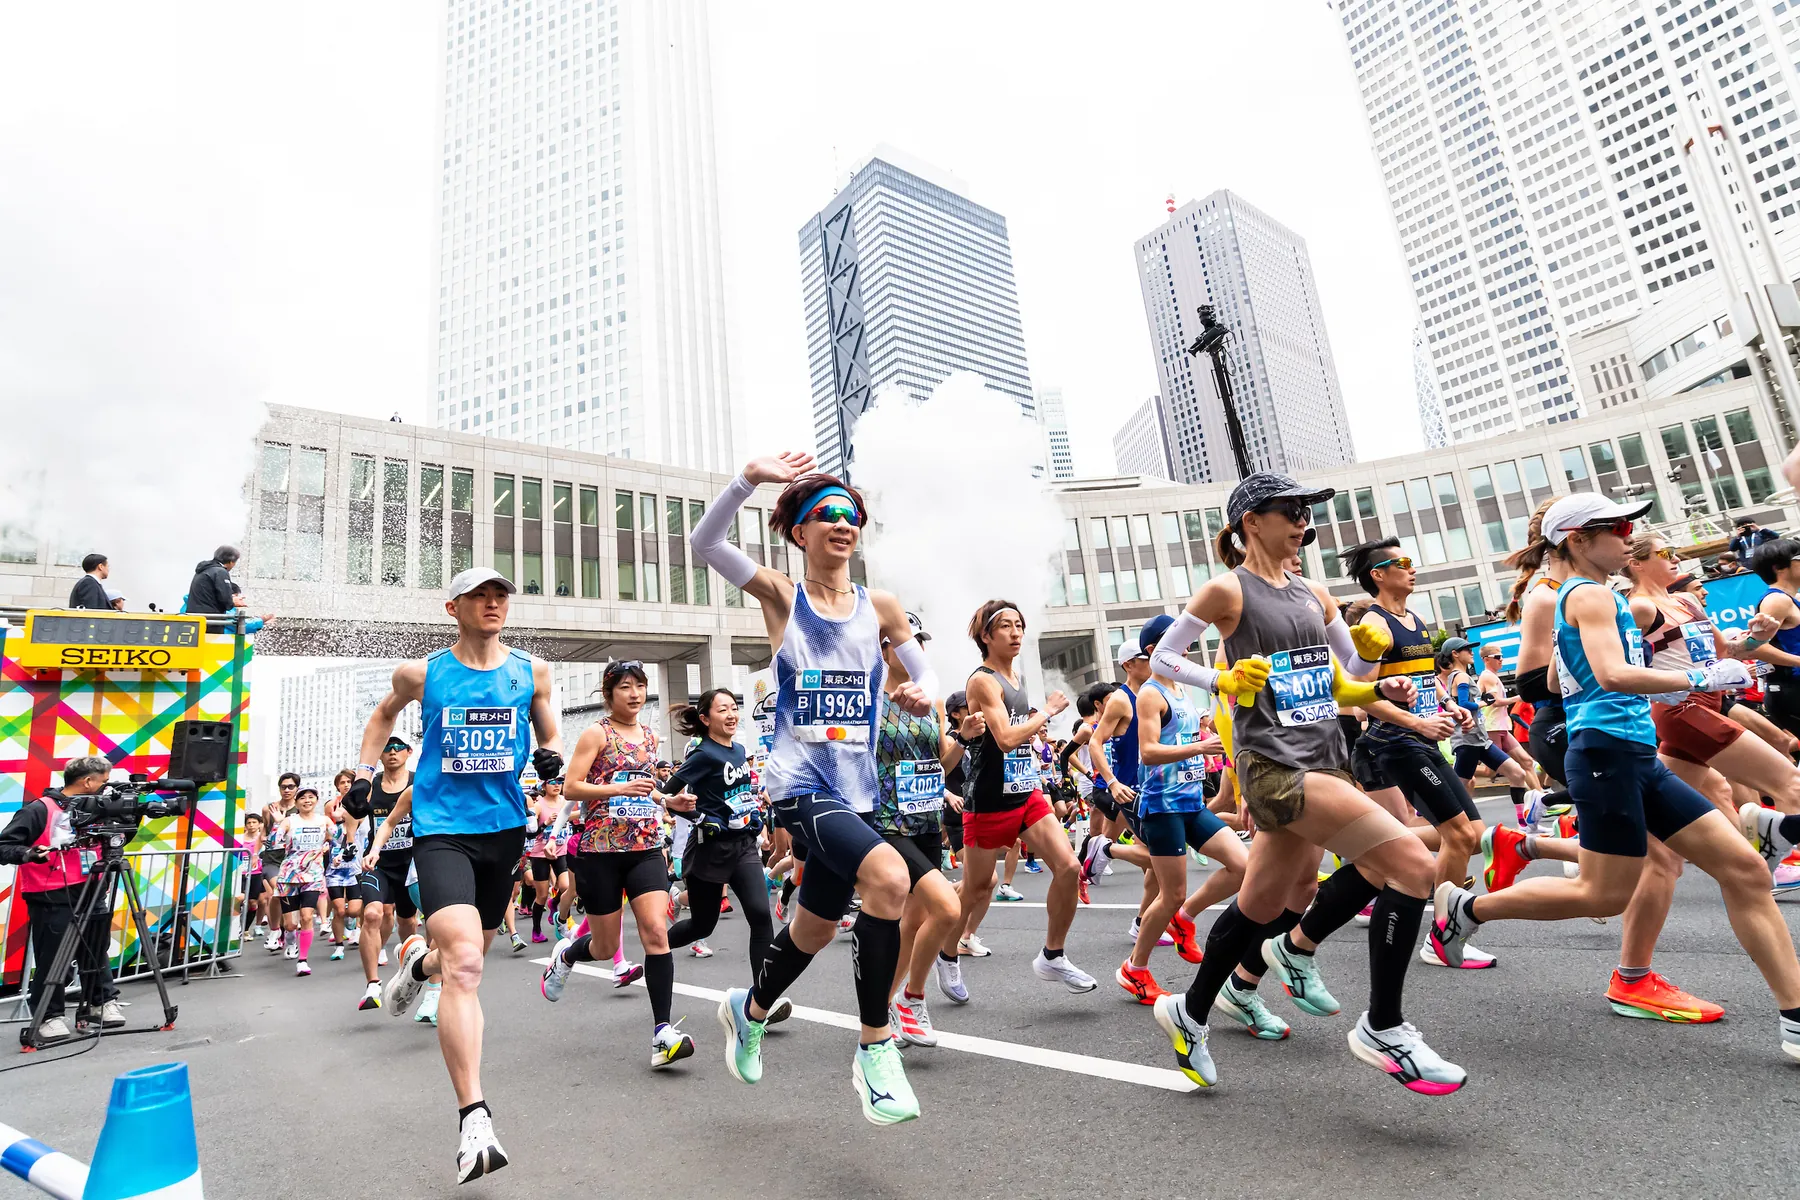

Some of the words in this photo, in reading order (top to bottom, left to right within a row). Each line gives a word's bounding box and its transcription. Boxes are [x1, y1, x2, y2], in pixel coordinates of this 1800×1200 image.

[61, 648, 171, 666] SEIKO
[825, 674, 864, 685] 東京メトロ
[797, 696, 809, 709] B
[816, 693, 865, 718] 19969
[468, 712, 510, 722] 東京メトロ
[798, 715, 804, 725] 1
[442, 731, 454, 744] A
[457, 729, 506, 751] 3092
[1420, 766, 1442, 786] 2XU
[898, 781, 907, 791] A
